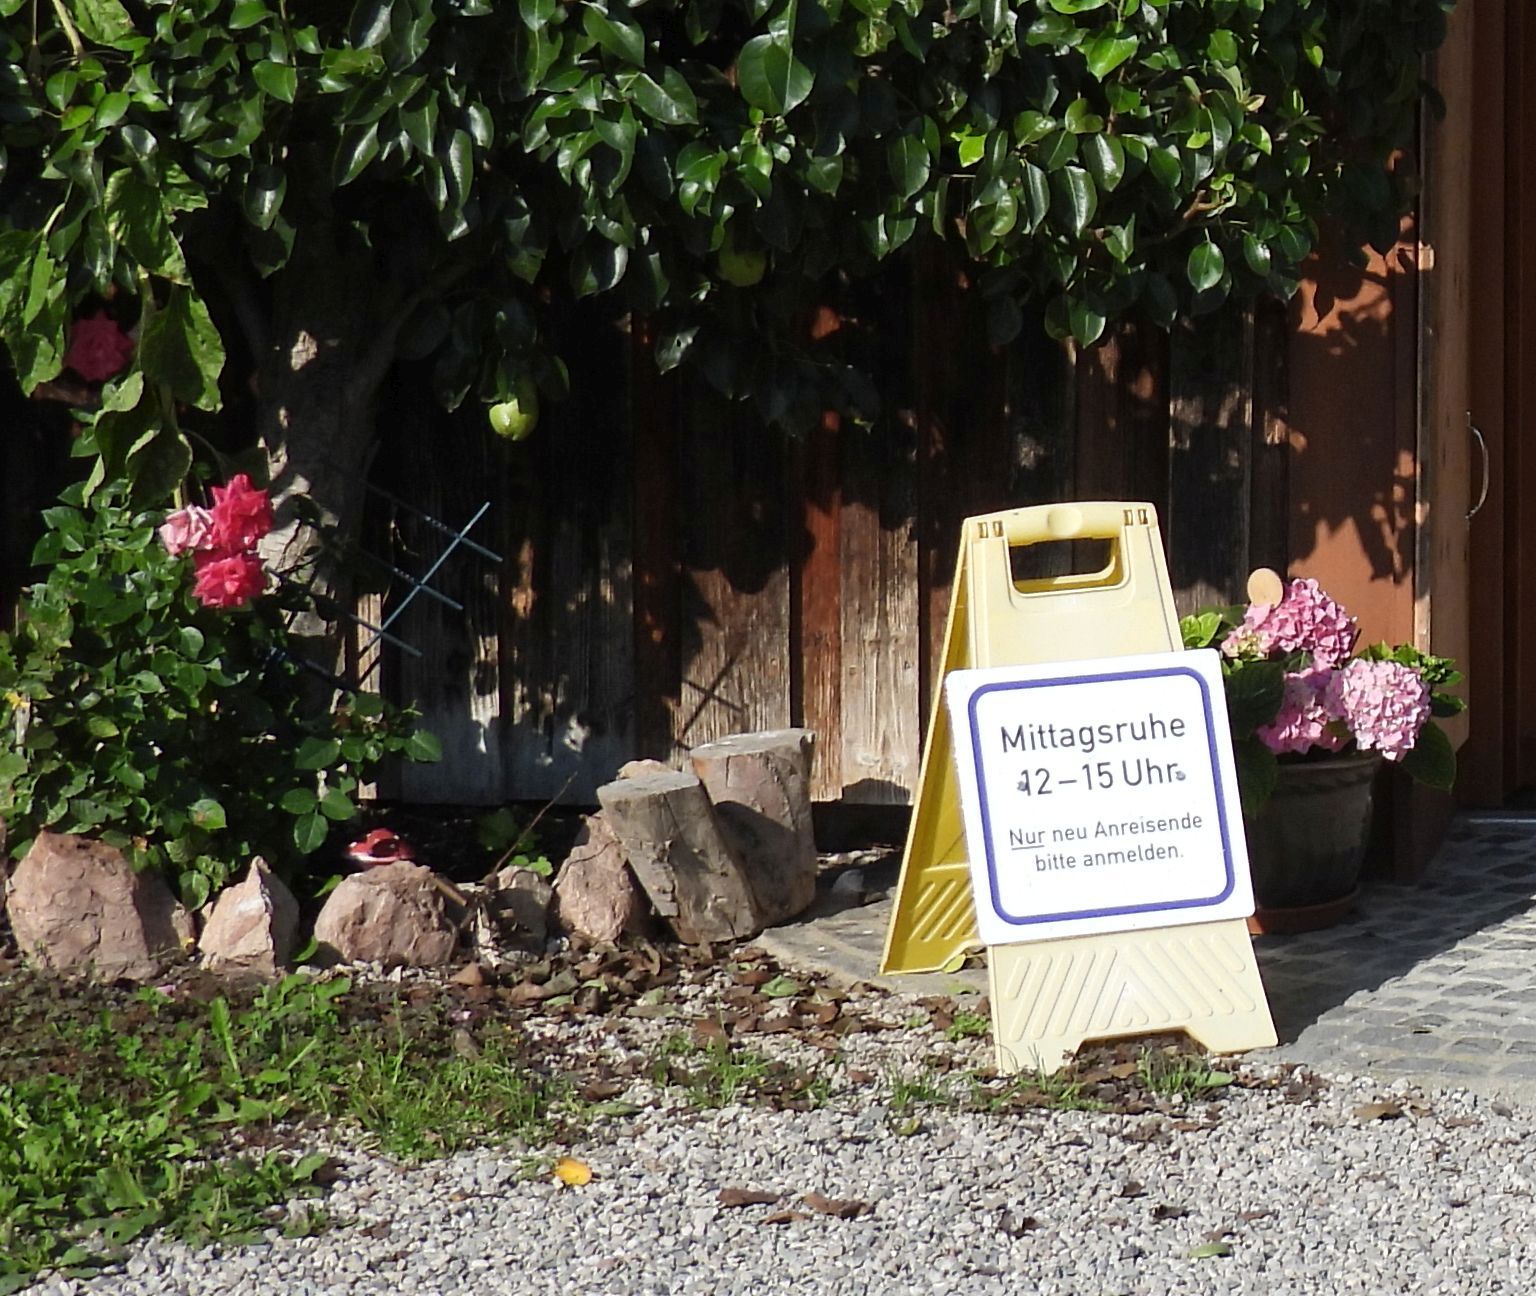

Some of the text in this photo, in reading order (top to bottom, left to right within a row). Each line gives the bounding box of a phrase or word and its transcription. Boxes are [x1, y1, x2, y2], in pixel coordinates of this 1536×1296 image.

[1000, 712, 1187, 756] Mittagsruhe
[1009, 811, 1203, 847] Nur neu Anreisende
[1034, 842, 1184, 872] bitte anmelden.
